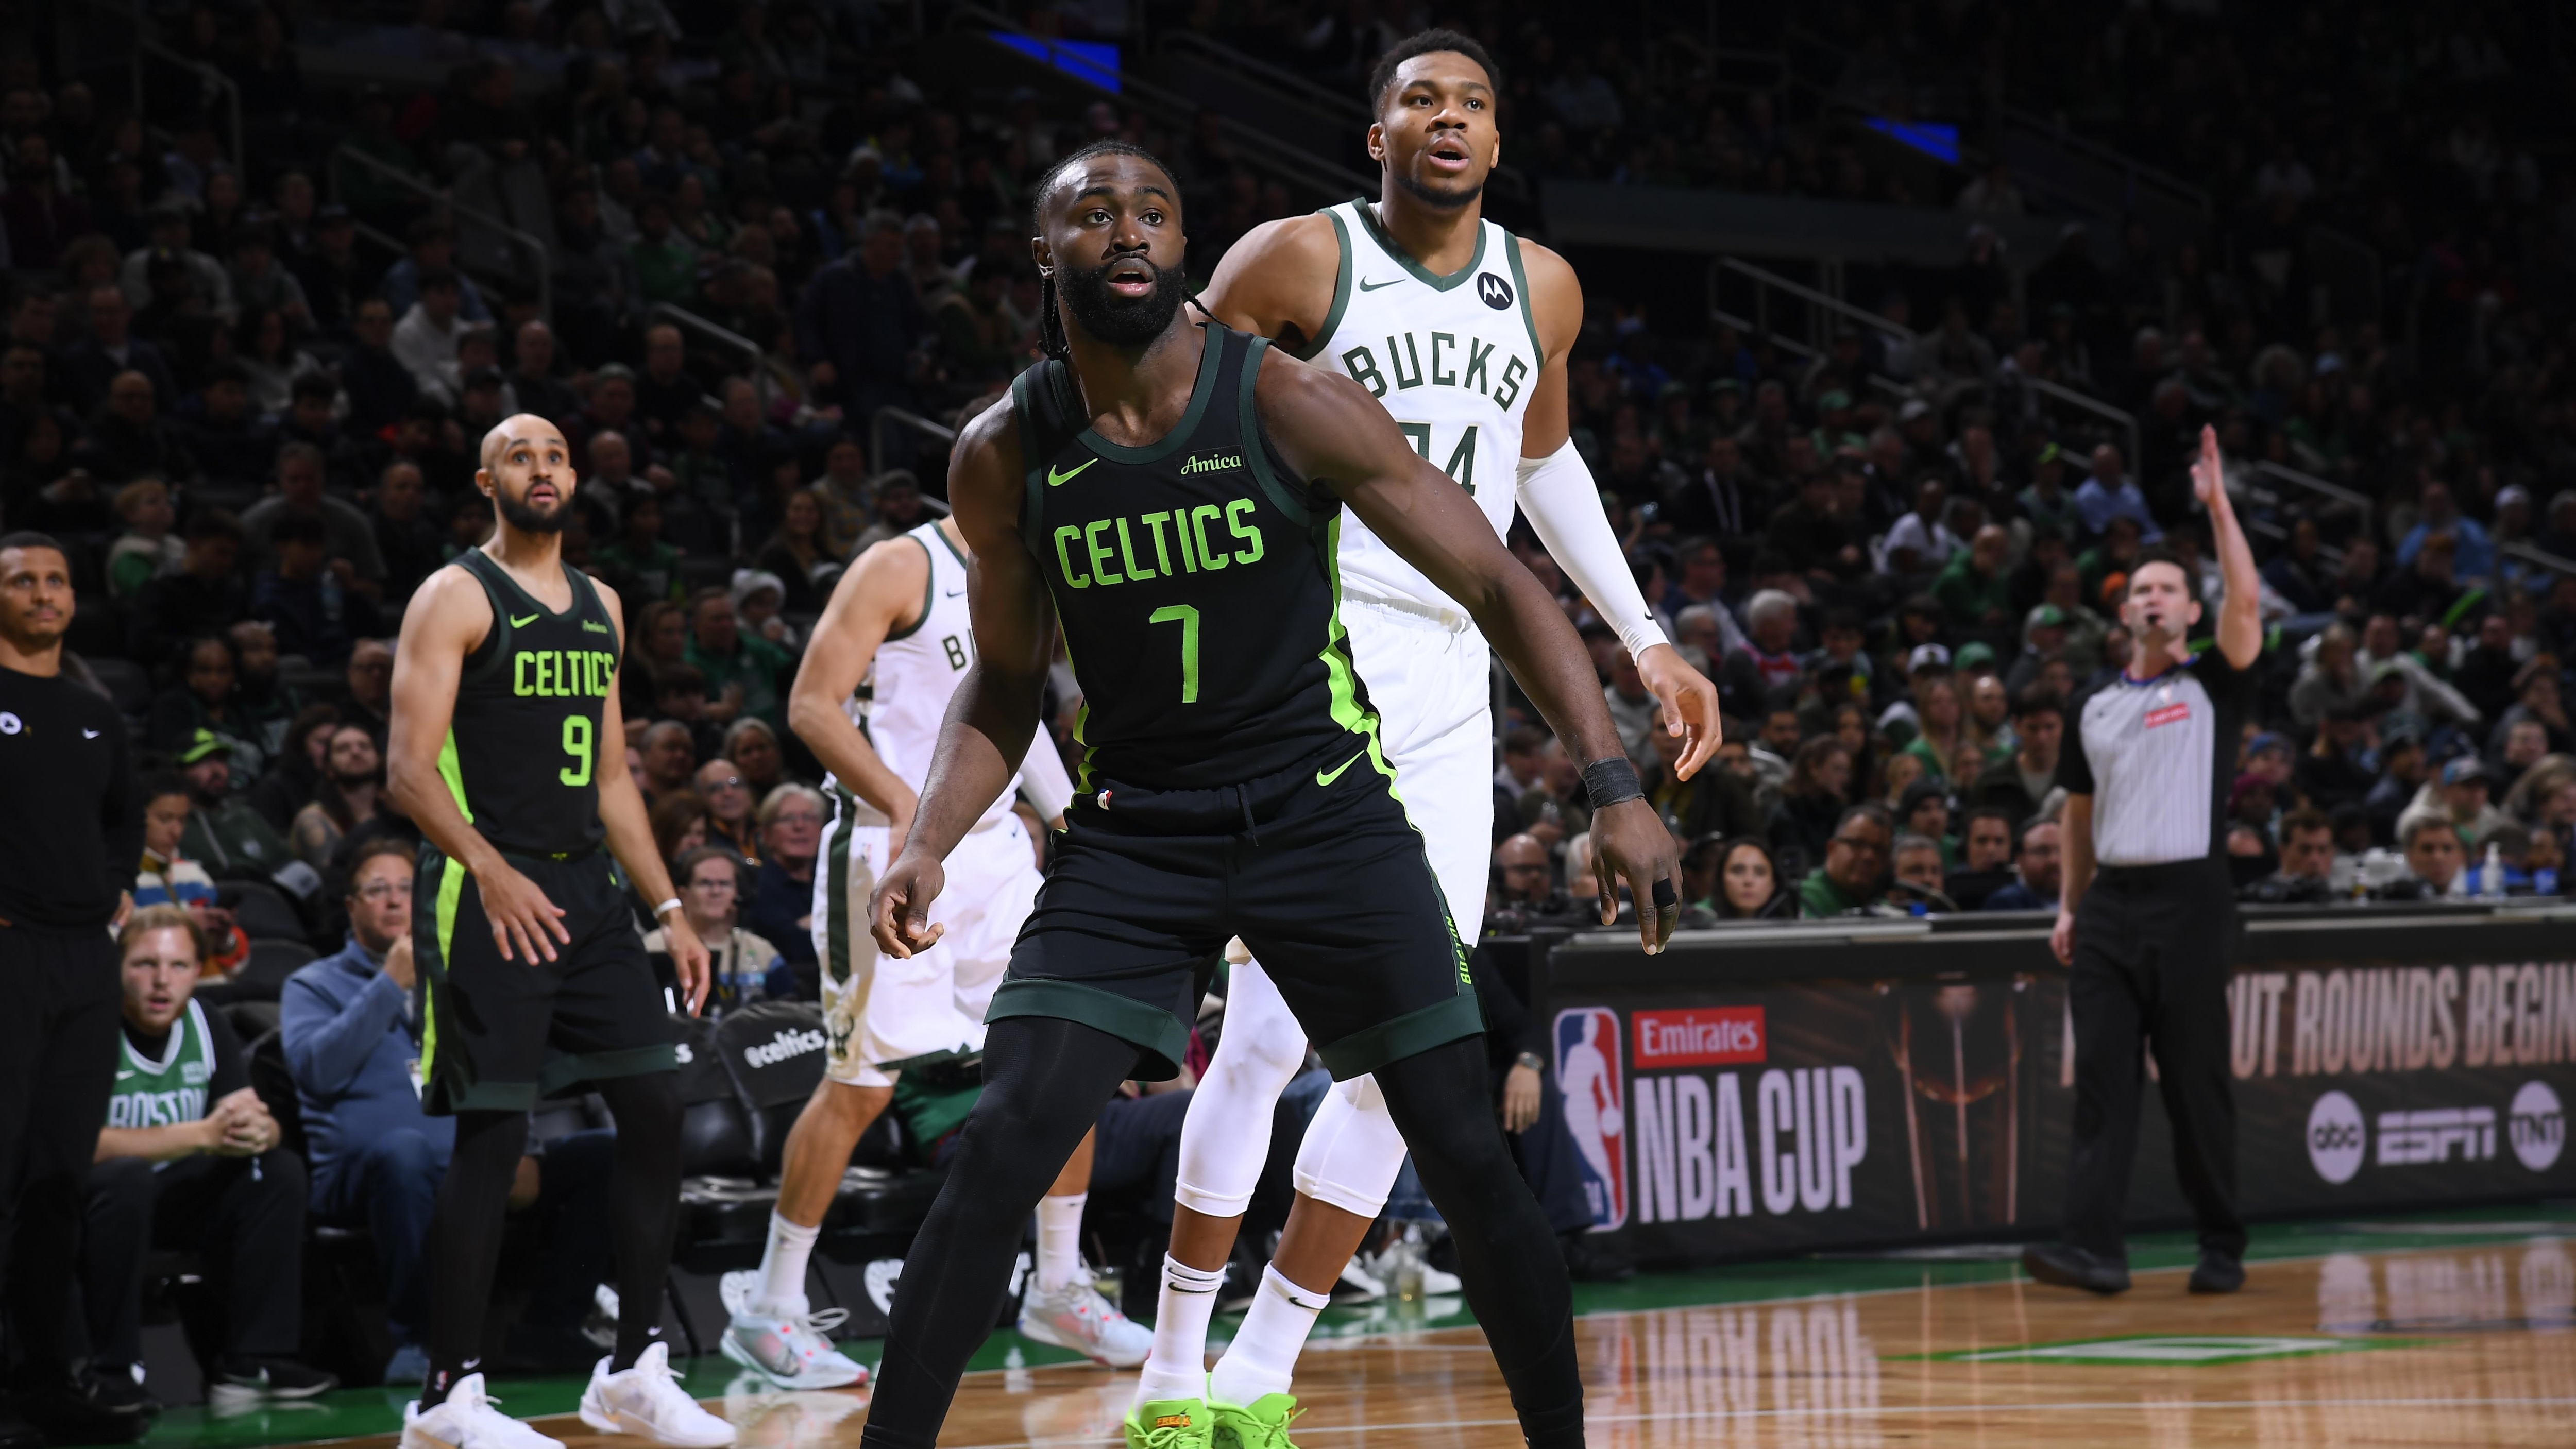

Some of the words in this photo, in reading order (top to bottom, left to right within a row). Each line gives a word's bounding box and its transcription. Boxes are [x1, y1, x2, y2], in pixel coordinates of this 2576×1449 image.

[1341, 331, 1528, 413] BUCKS
[1180, 453, 1242, 476] Amica
[1053, 497, 1265, 589] CELTICS
[513, 649, 615, 698] CELTICS
[1148, 603, 1199, 705] 7
[558, 713, 594, 787] 9
[1445, 915, 1472, 985] BOSTON
[744, 1027, 826, 1069] @celtics
[1640, 1015, 1759, 1058] Emirates
[2291, 965, 2460, 1077] ROUNDS
[1632, 1072, 1754, 1225] NBA
[1757, 1065, 1869, 1216] CUP
[2314, 1118, 2360, 1151] abc
[2376, 1105, 2498, 1166] ESPN
[2510, 1113, 2564, 1146] TNT
